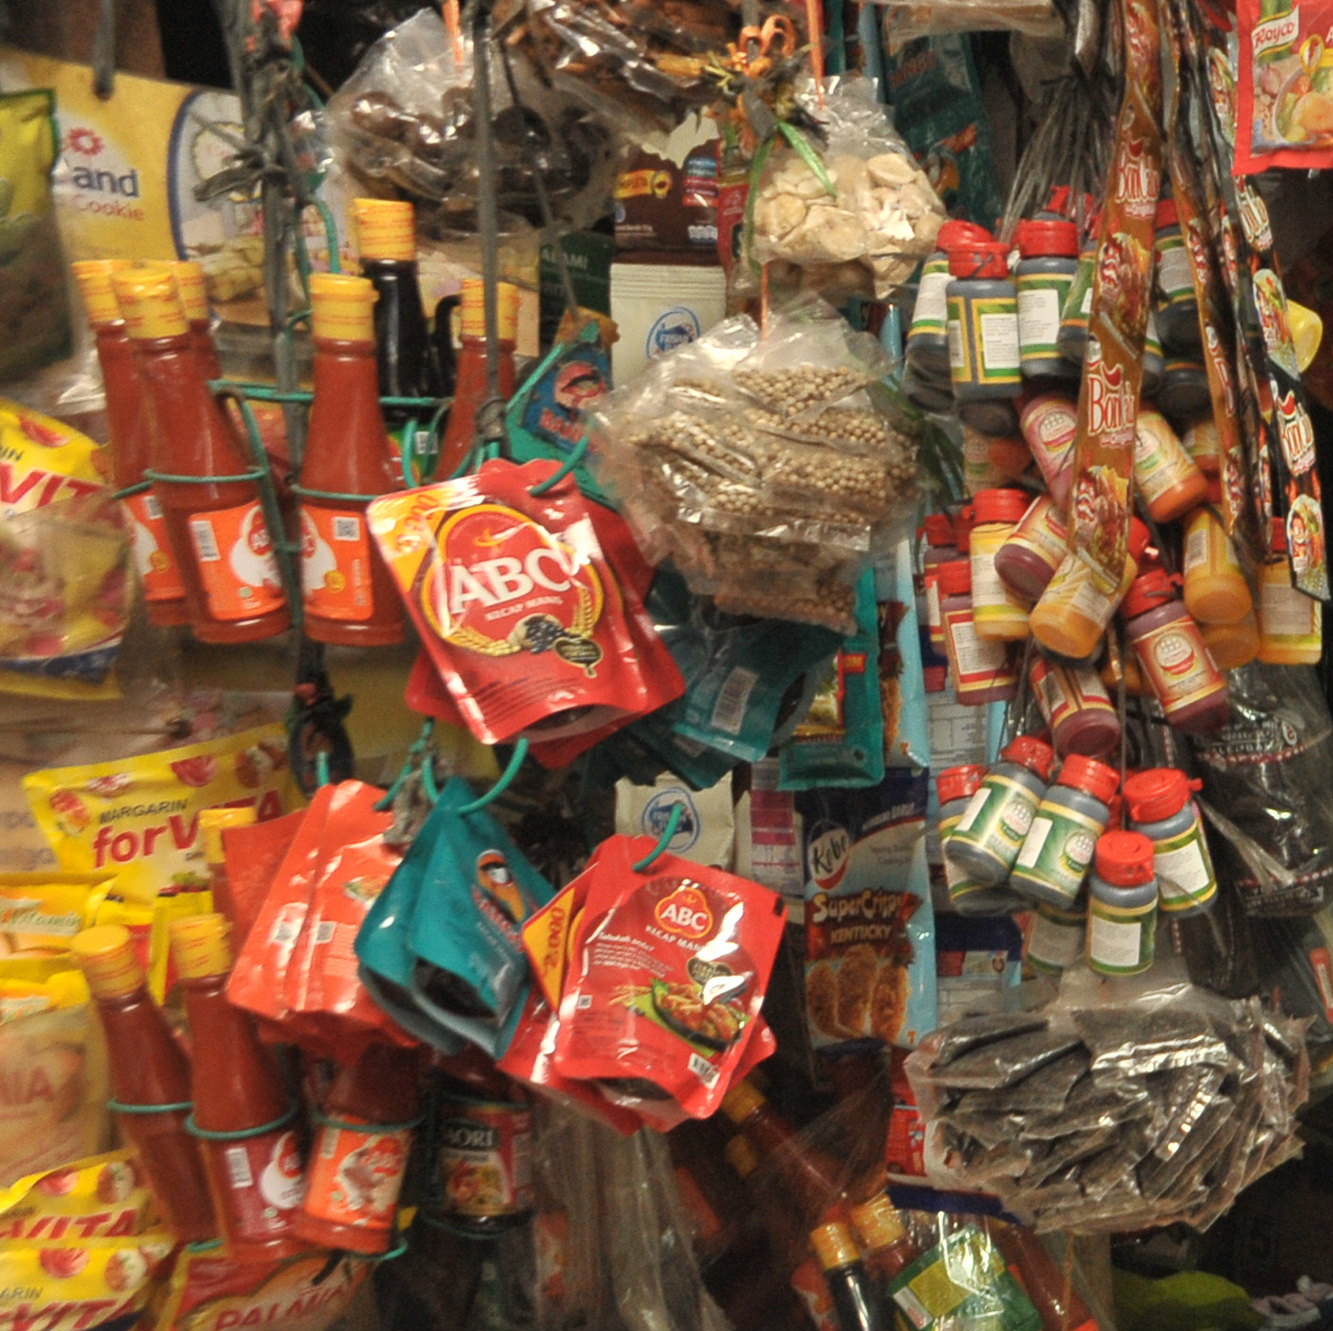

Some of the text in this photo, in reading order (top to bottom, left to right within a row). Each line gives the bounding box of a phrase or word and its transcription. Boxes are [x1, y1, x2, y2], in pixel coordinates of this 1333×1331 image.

[1254, 22, 1295, 48] Royco
[449, 548, 571, 614] ABC
[100, 798, 189, 824] MARGARIN
[660, 903, 710, 931] ABC
